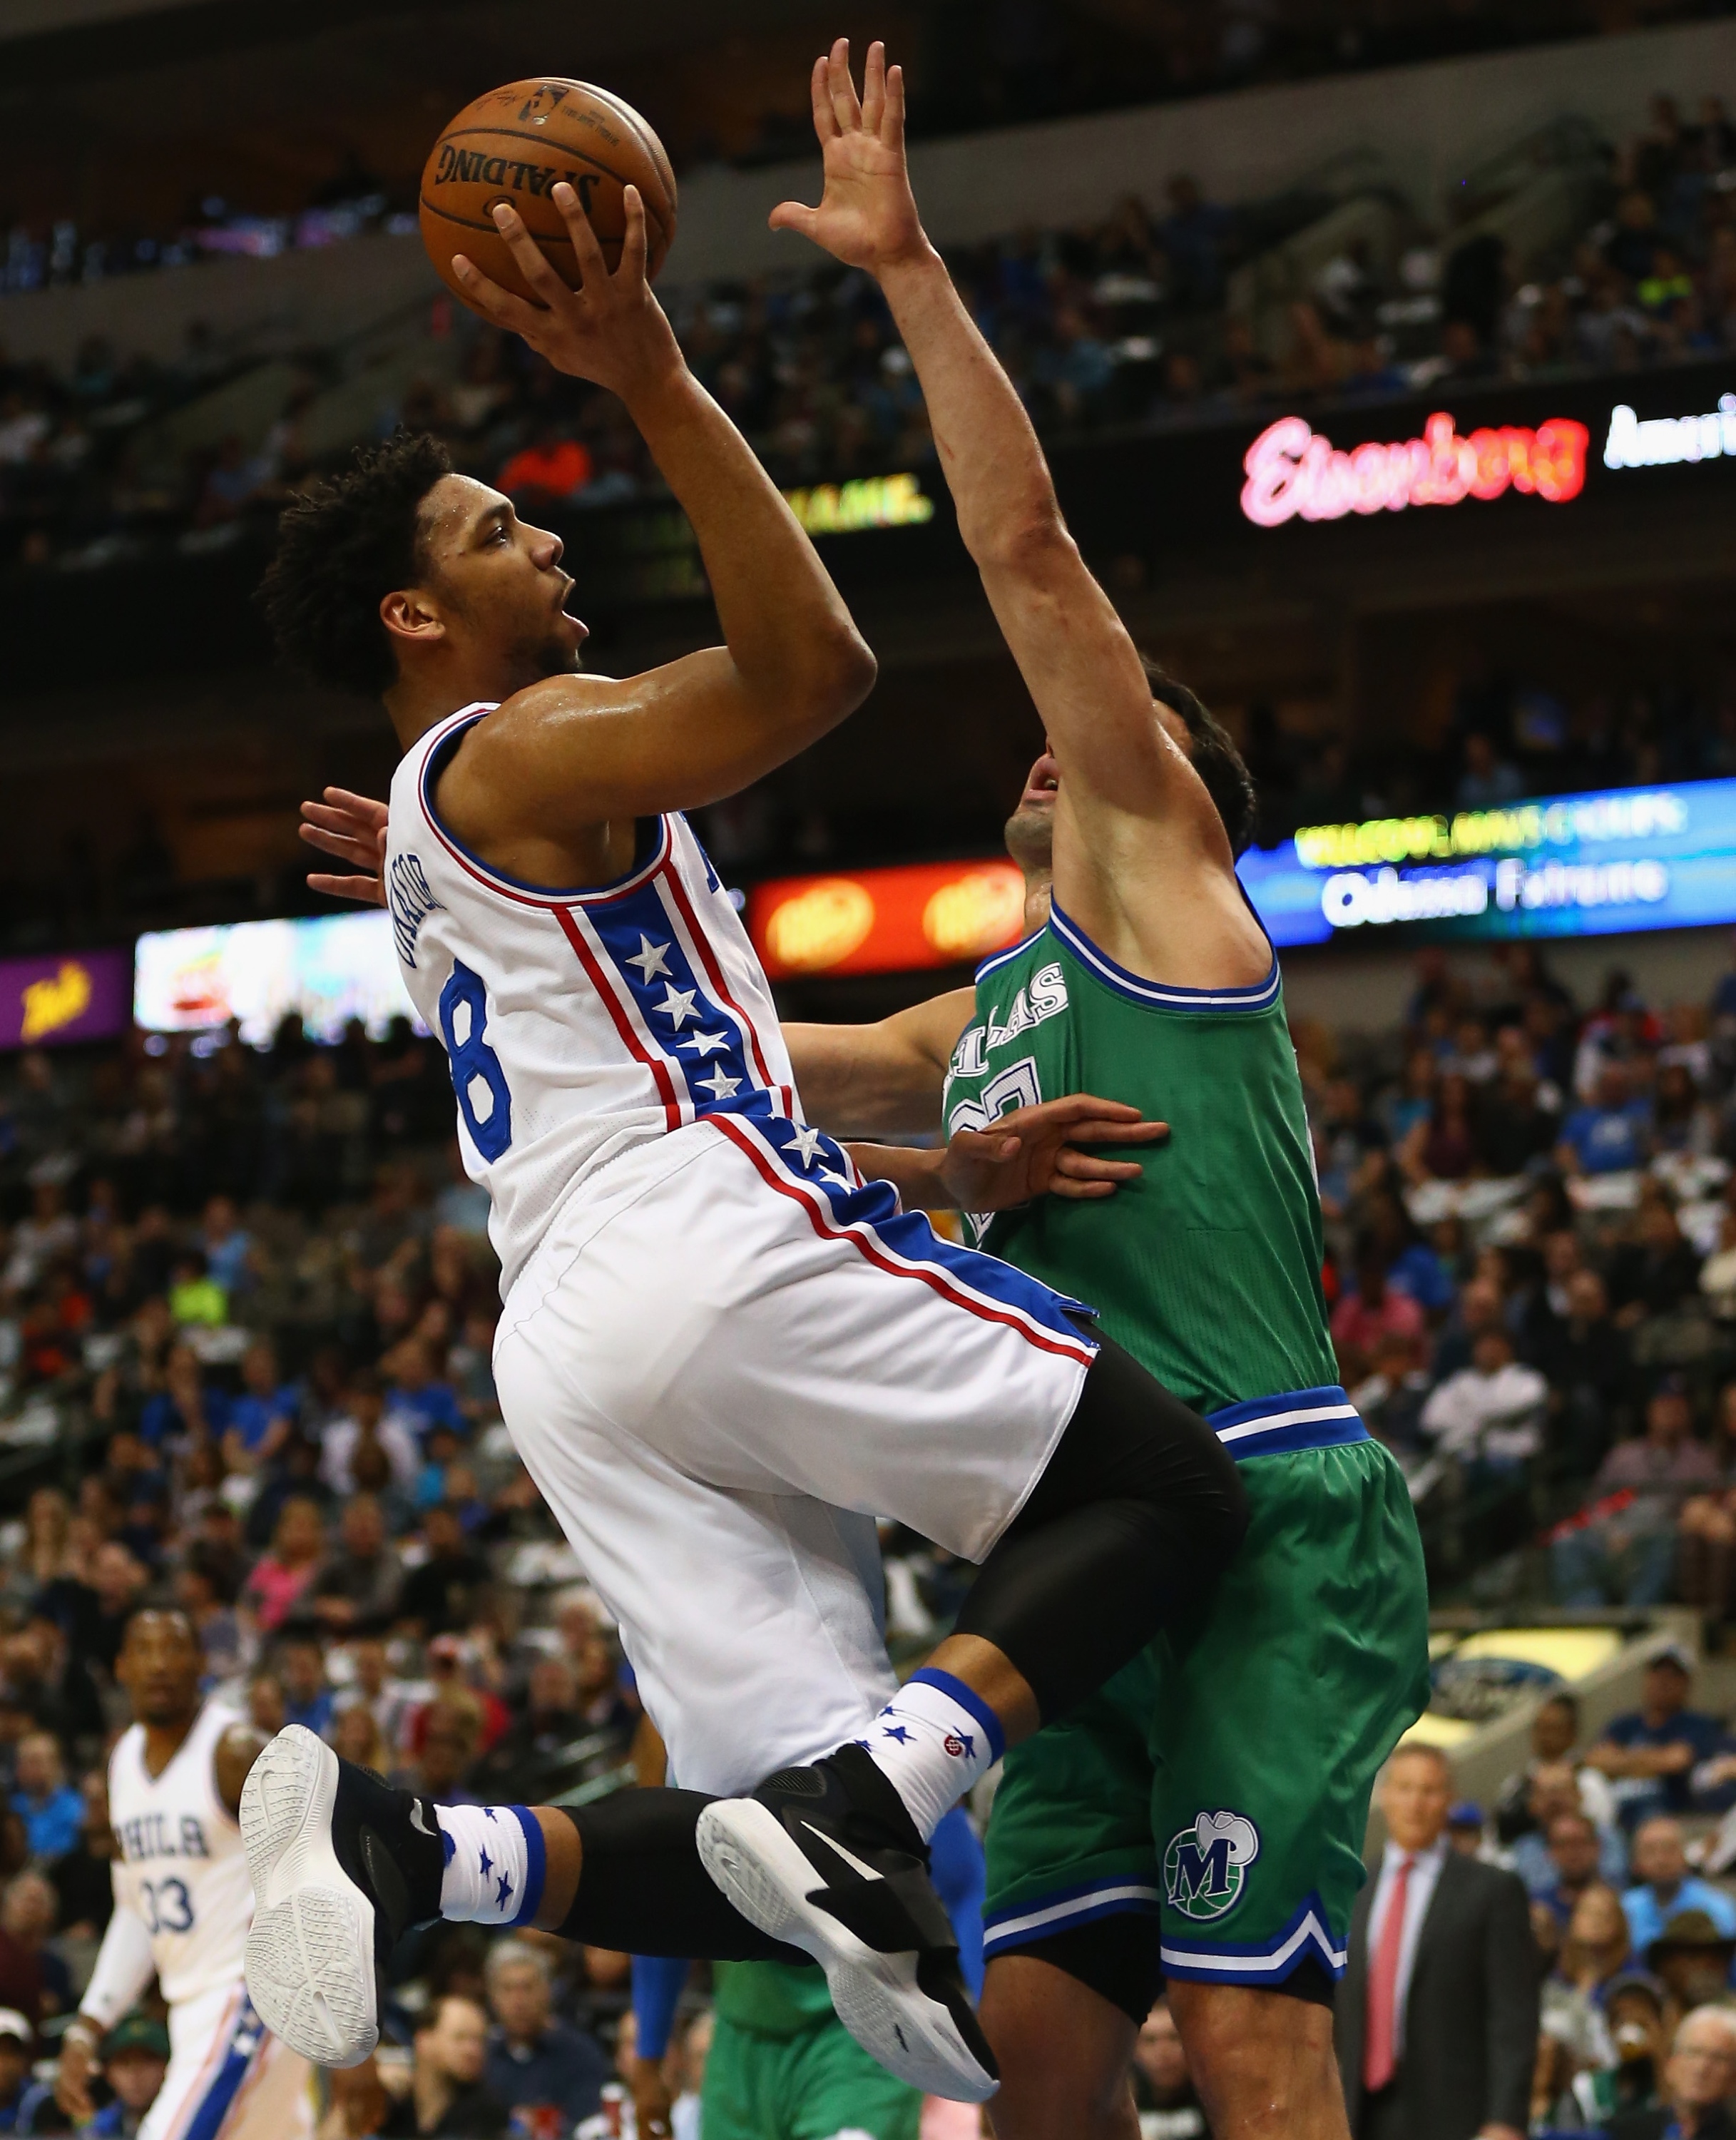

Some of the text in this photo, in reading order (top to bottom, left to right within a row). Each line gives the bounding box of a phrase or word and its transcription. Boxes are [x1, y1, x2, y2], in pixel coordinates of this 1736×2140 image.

[435, 143, 601, 215] SPALDING
[439, 958, 512, 1165] 8
[944, 962, 1068, 1091] LLAS
